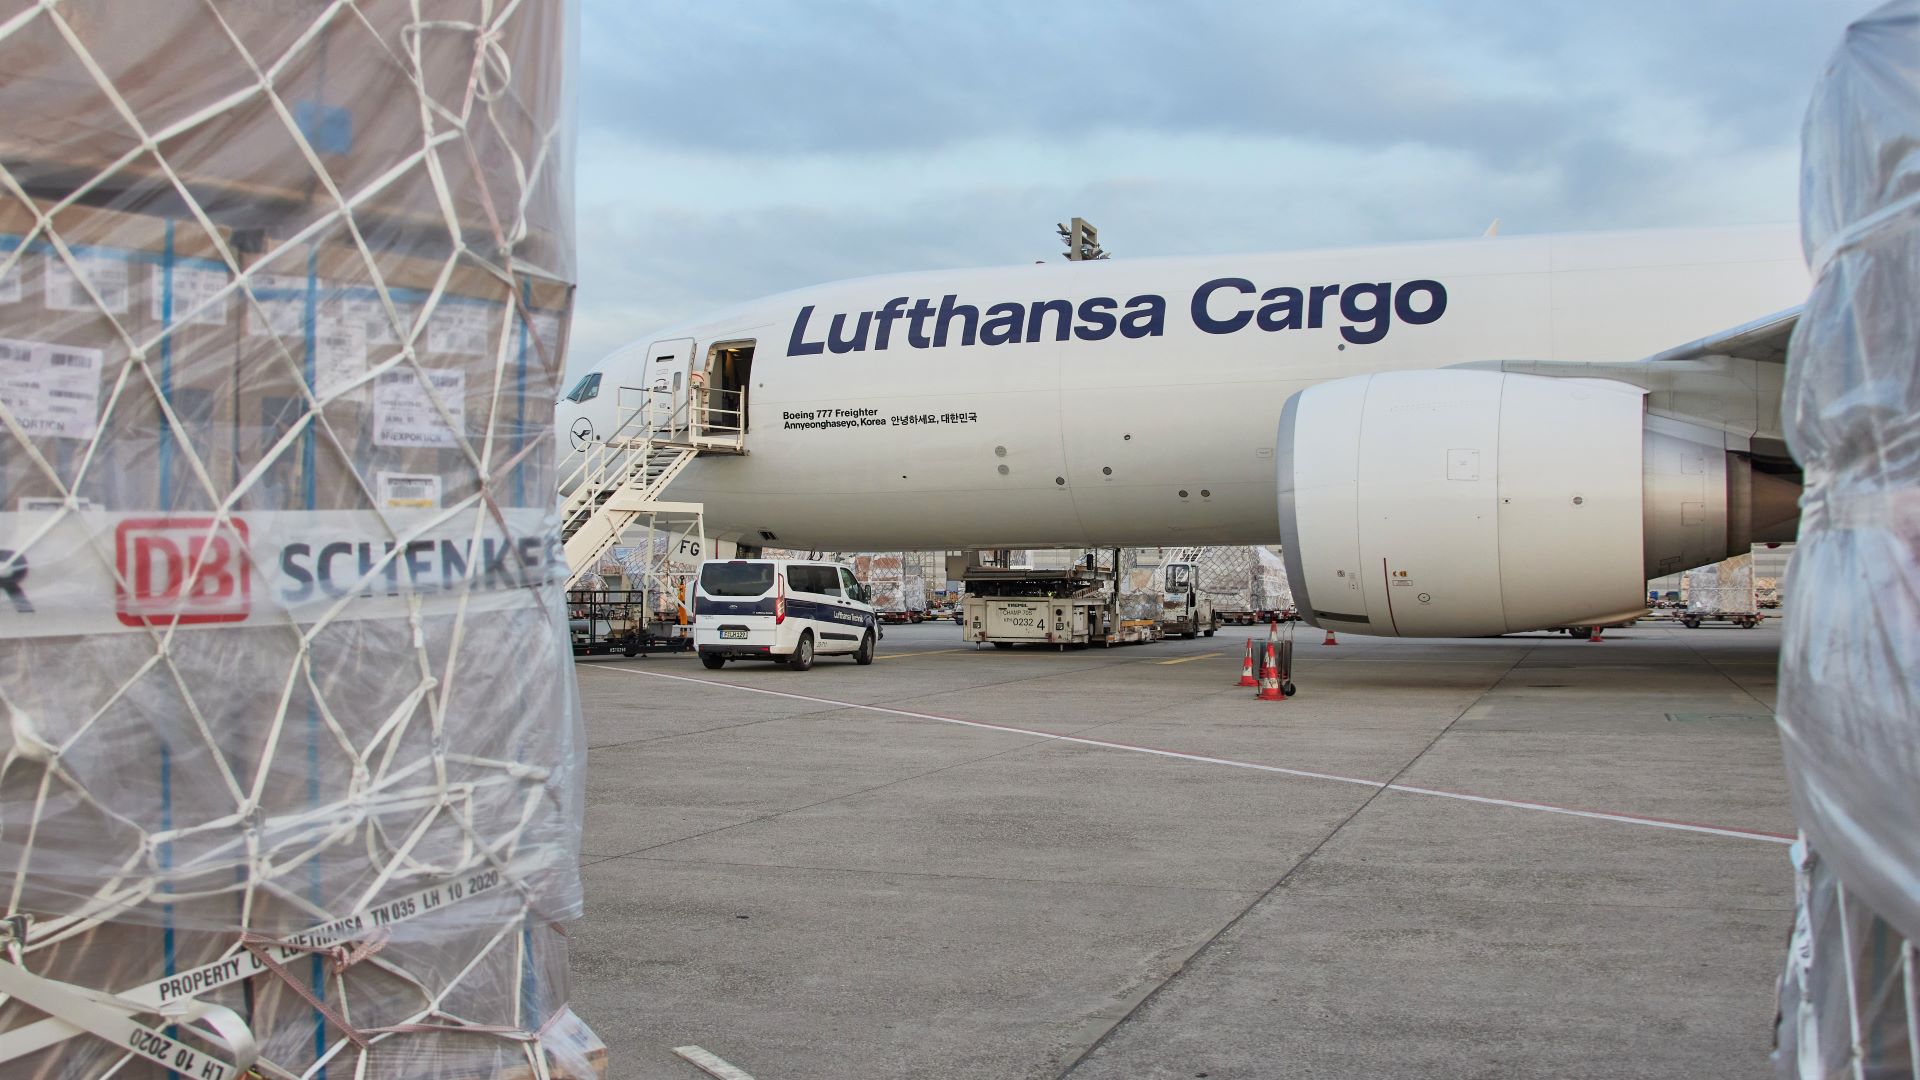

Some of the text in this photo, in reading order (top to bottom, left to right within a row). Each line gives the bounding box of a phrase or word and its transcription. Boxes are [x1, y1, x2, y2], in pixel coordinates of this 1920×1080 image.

[786, 277, 1448, 357] Lufthansa Cargo
[783, 408, 878, 420] Boeing 777 Freighter
[890, 412, 977, 426] 안녕하세요, 대한민국
[784, 417, 886, 430] Annyeonghaseyo, Korea
[679, 539, 700, 557] FG
[134, 537, 234, 601] DB
[280, 536, 561, 603] SCHENKE
[833, 610, 852, 621] Lufthansa
[1012, 617, 1034, 627] 0232
[1036, 618, 1046, 631] 4
[159, 957, 241, 1002] PROPERTY
[370, 905, 391, 926] TN
[391, 897, 417, 921] 035
[422, 891, 441, 909] LH
[447, 883, 463, 901] 10
[468, 869, 500, 894] 2020
[129, 1028, 224, 1080] LH 10 2020
